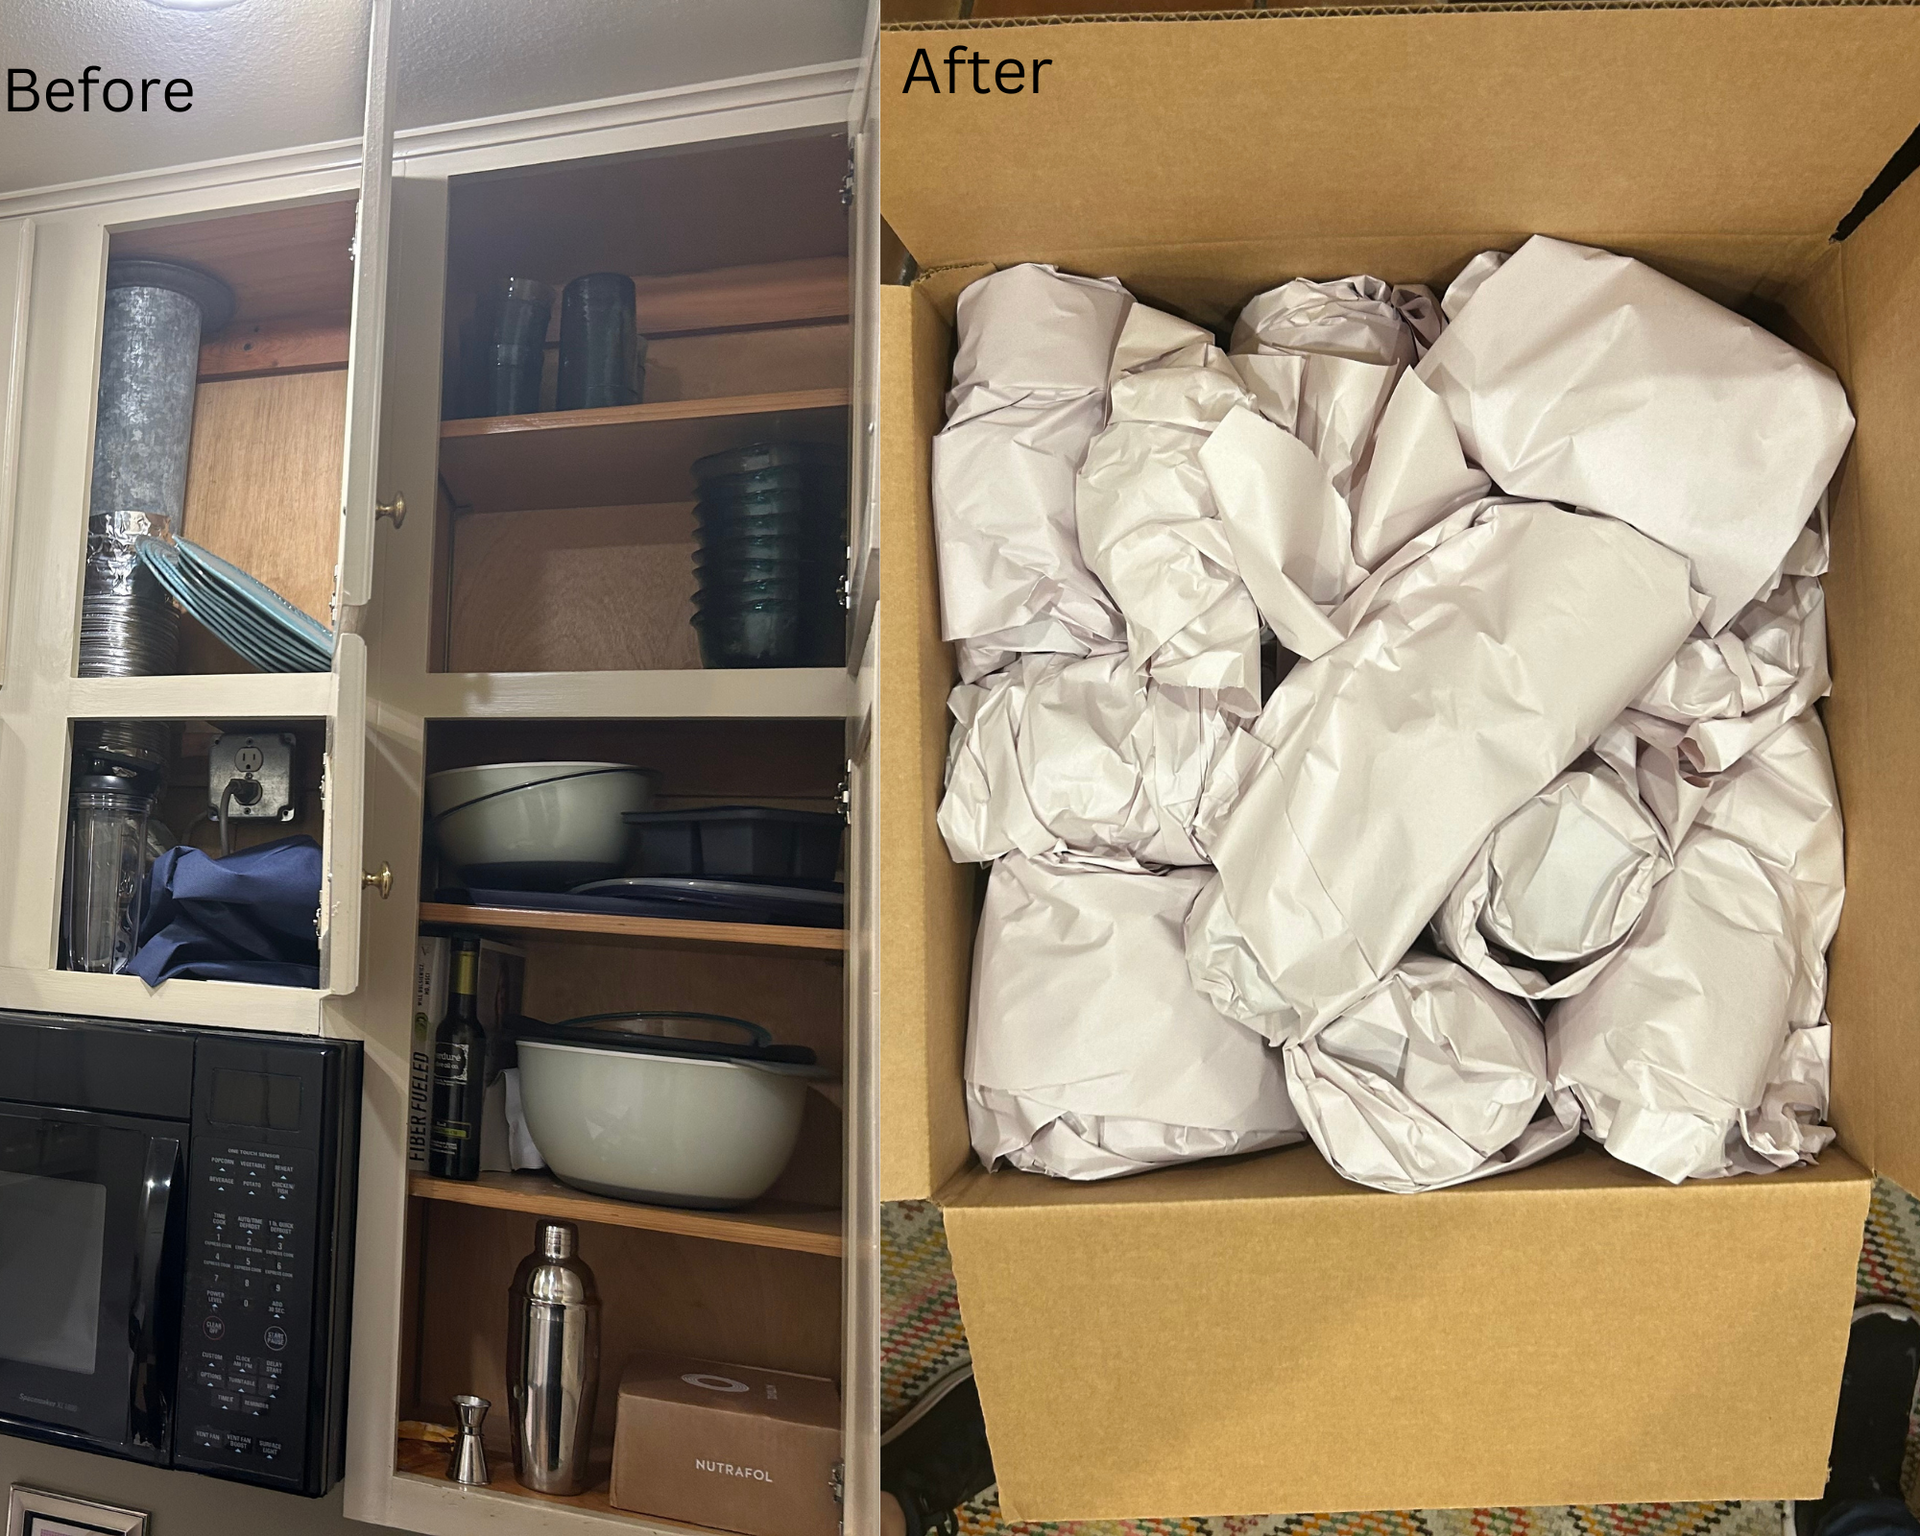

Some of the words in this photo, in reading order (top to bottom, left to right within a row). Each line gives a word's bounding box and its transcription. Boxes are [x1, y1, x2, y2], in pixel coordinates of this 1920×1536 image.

[411, 1051, 429, 1112] FUELED
[409, 1115, 427, 1162] FIBER
[240, 1149, 257, 1157] TOUCH
[259, 1151, 280, 1159] SENSOR
[211, 1157, 235, 1165] POPCORN
[240, 1160, 266, 1169] VEGETABLE
[274, 1164, 294, 1172] REHEAT
[209, 1175, 234, 1185] BEVERAGE
[243, 1180, 262, 1188] POTATO
[213, 1212, 226, 1220] TIME
[239, 1222, 261, 1230] DEFROST
[279, 1221, 294, 1229] QUICK
[270, 1226, 292, 1235] DEFROST
[246, 1238, 252, 1246] 2
[277, 1242, 283, 1250] 3
[215, 1252, 220, 1260] 4
[246, 1257, 251, 1266] 5
[276, 1262, 282, 1270] 6
[214, 1274, 219, 1282] 7
[244, 1279, 250, 1287] 8
[275, 1284, 281, 1292] 9
[206, 1290, 225, 1298] POWER
[208, 1296, 223, 1304] LEVEL
[243, 1299, 249, 1307] 0
[267, 1338, 284, 1346] PAUSE
[202, 1351, 223, 1360] CUSTOM
[266, 1360, 283, 1368] DELAY
[266, 1366, 282, 1374] START
[200, 1371, 222, 1381] OPTIONS
[228, 1377, 255, 1386] TURNTABLE
[18, 1392, 57, 1408] Spacemaker
[217, 1394, 234, 1402] TIMER
[244, 1400, 269, 1409] REMINDER
[196, 1430, 209, 1438] VENT
[209, 1433, 220, 1441] FAN
[226, 1433, 240, 1441] VENT
[240, 1436, 252, 1444] FAN
[230, 1441, 247, 1449] BOOST
[259, 1440, 282, 1450] SURFACE
[262, 1447, 278, 1455] LIGHT
[695, 1458, 773, 1483] NUTRAFOL
